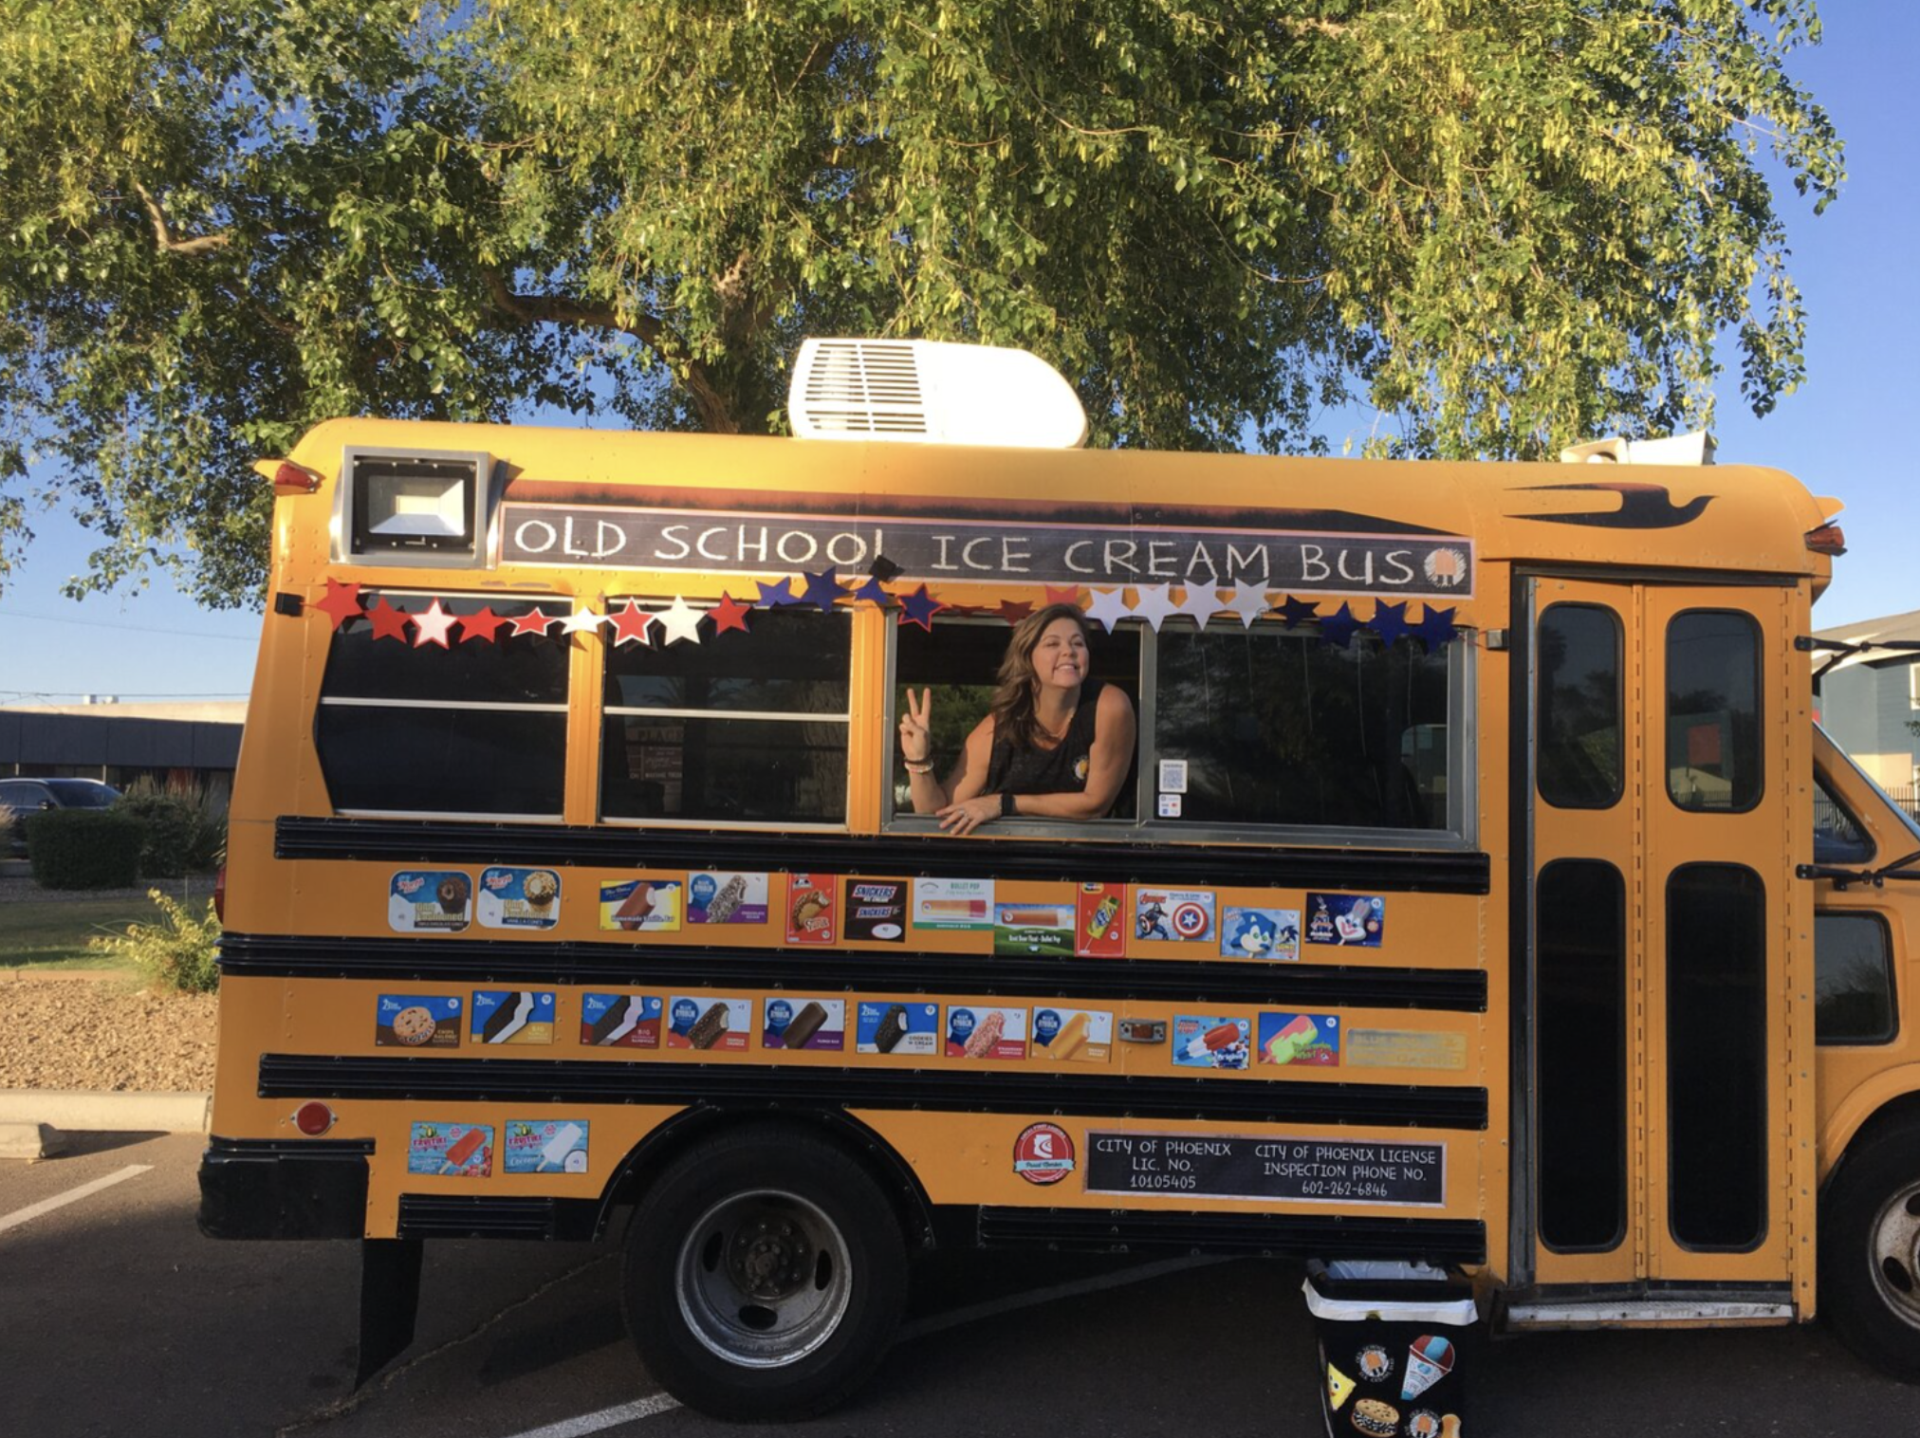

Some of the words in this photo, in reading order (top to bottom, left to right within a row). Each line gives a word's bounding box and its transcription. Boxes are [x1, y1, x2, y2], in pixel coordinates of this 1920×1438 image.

[514, 515, 627, 558] OLD
[654, 523, 883, 565] SCHOOL
[931, 535, 1031, 573] ICE
[1064, 540, 1271, 580] CREAM
[1302, 544, 1415, 586] BUS
[854, 885, 896, 897] SNICKERS
[858, 907, 891, 917] SNICKERS
[1096, 1139, 1133, 1155] CITY
[1139, 1140, 1159, 1154] OF
[1165, 1141, 1232, 1157] PHOENIX
[1255, 1144, 1287, 1159] CITY
[1293, 1145, 1310, 1159] OF
[1316, 1147, 1375, 1162] PHOENIX
[1380, 1148, 1437, 1165] LICENSE
[1132, 1157, 1161, 1171] LIC.
[1168, 1159, 1194, 1173] NO.
[1263, 1162, 1347, 1178] INSPECTION
[1352, 1165, 1397, 1181] PHONE
[1403, 1168, 1427, 1181] NO.
[1129, 1174, 1197, 1189] 10105405
[1302, 1181, 1388, 1197] 602-262-6846
